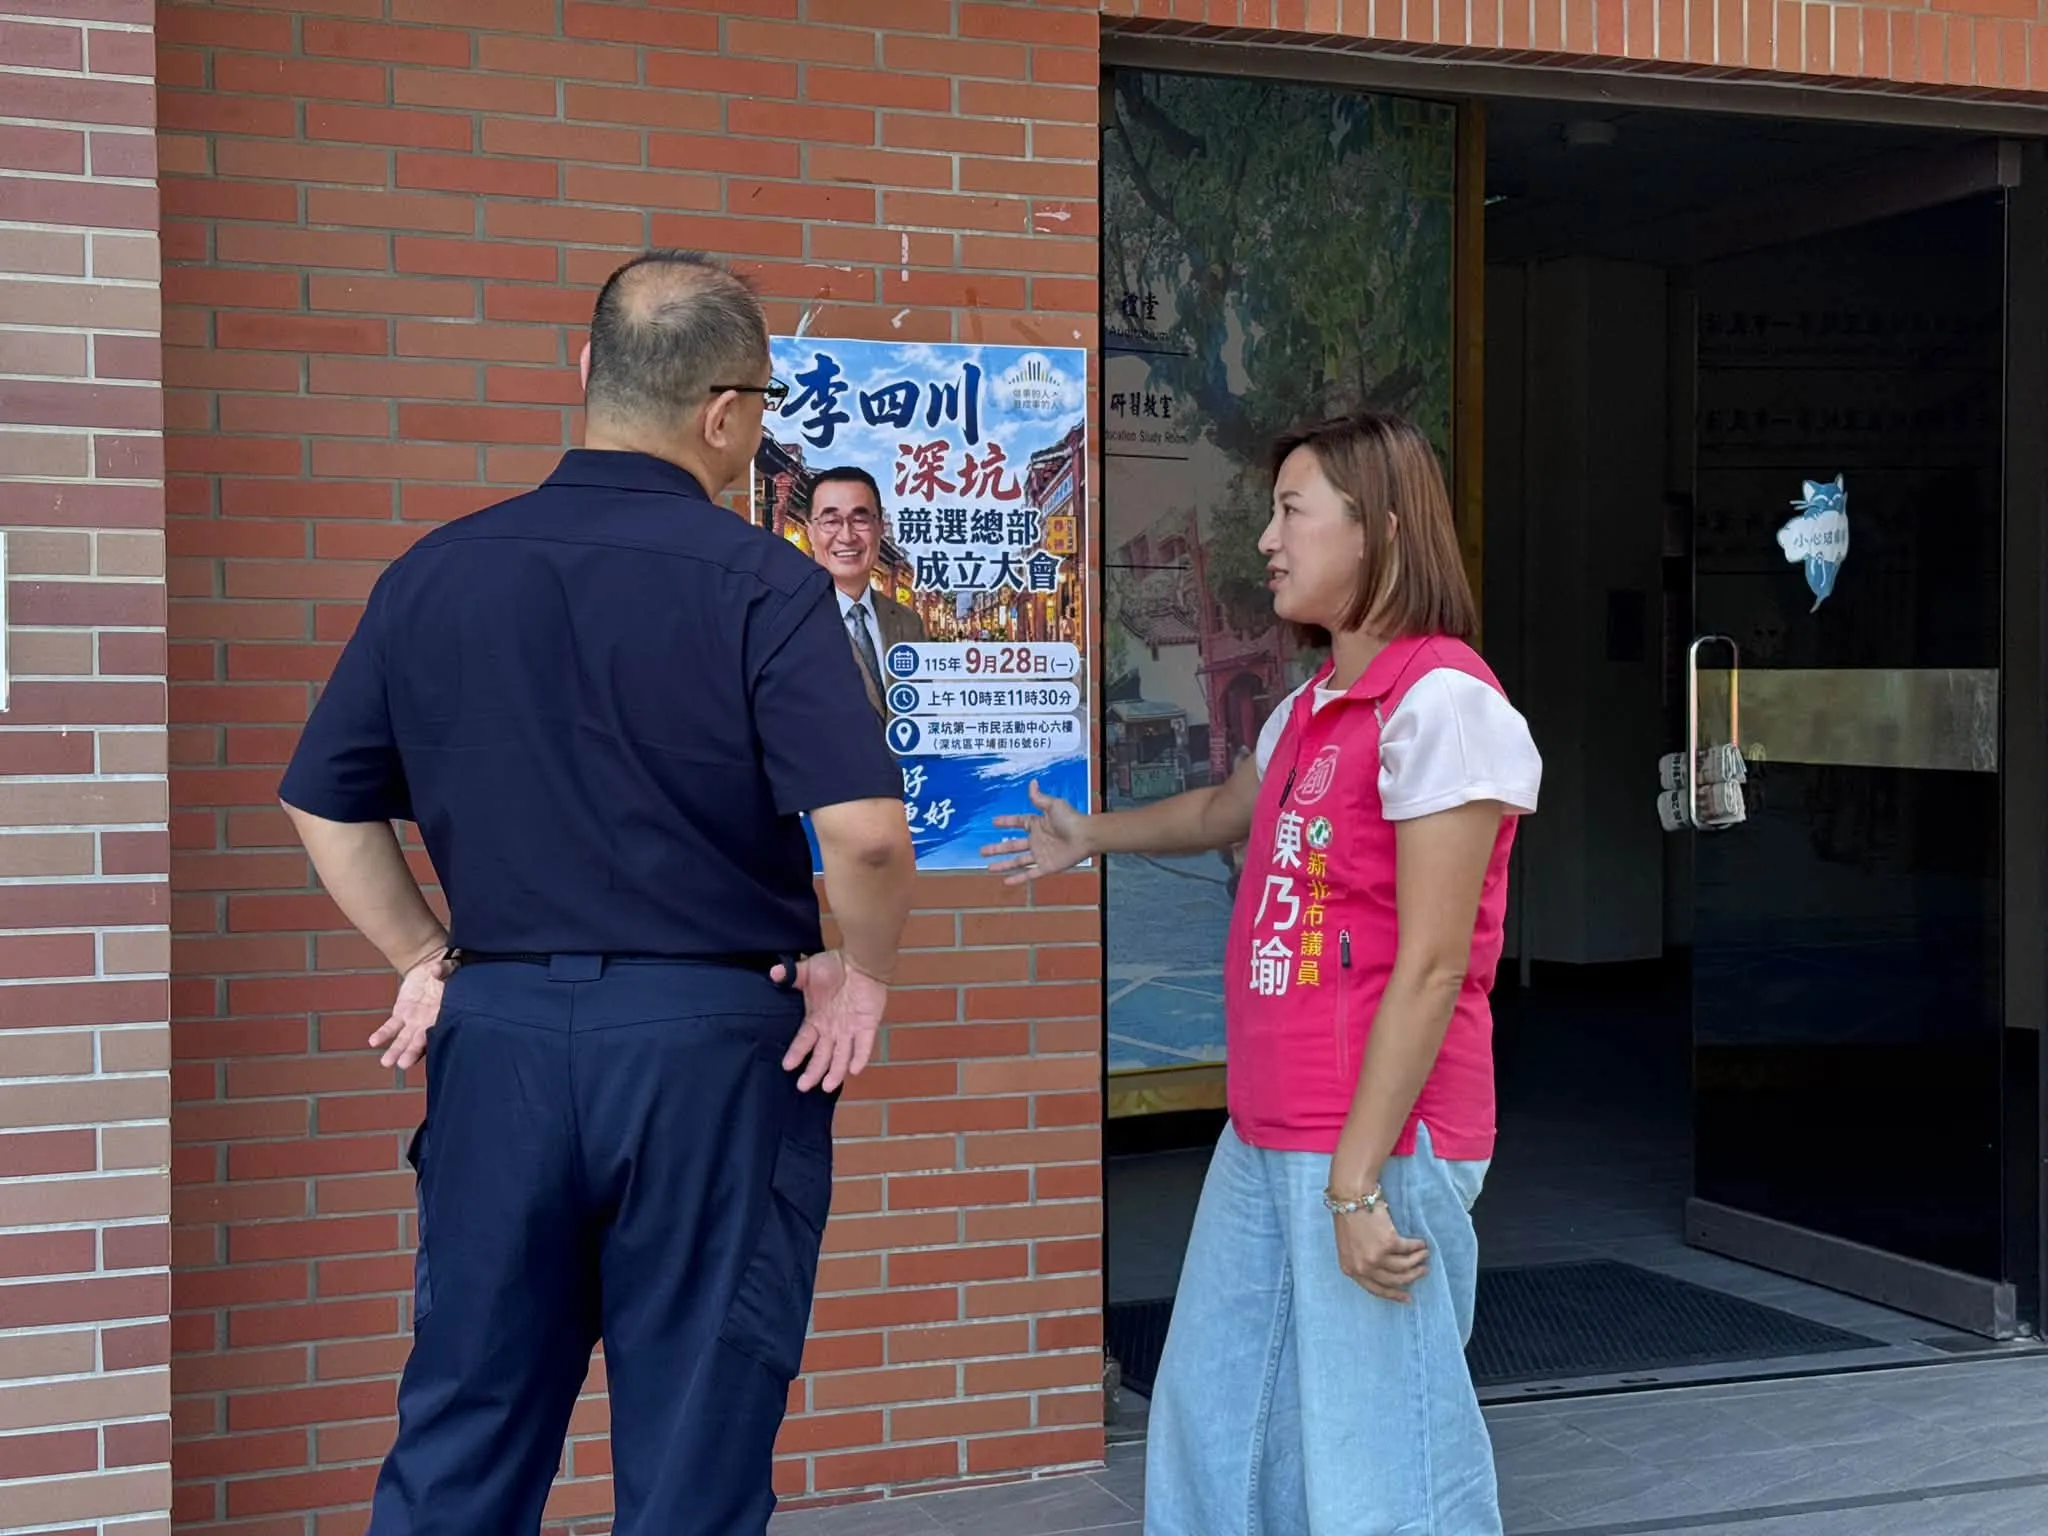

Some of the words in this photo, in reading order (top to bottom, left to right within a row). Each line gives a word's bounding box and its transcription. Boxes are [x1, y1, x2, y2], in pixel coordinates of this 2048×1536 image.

[781, 353, 981, 448] 李四川
[895, 441, 1022, 502] 深坑
[897, 508, 1040, 546] 競選總部
[914, 551, 1061, 591] 成立大會
[927, 720, 1073, 735] 深坑第一市民活動中心六樓
[1296, 851, 1331, 987] 新北市議員
